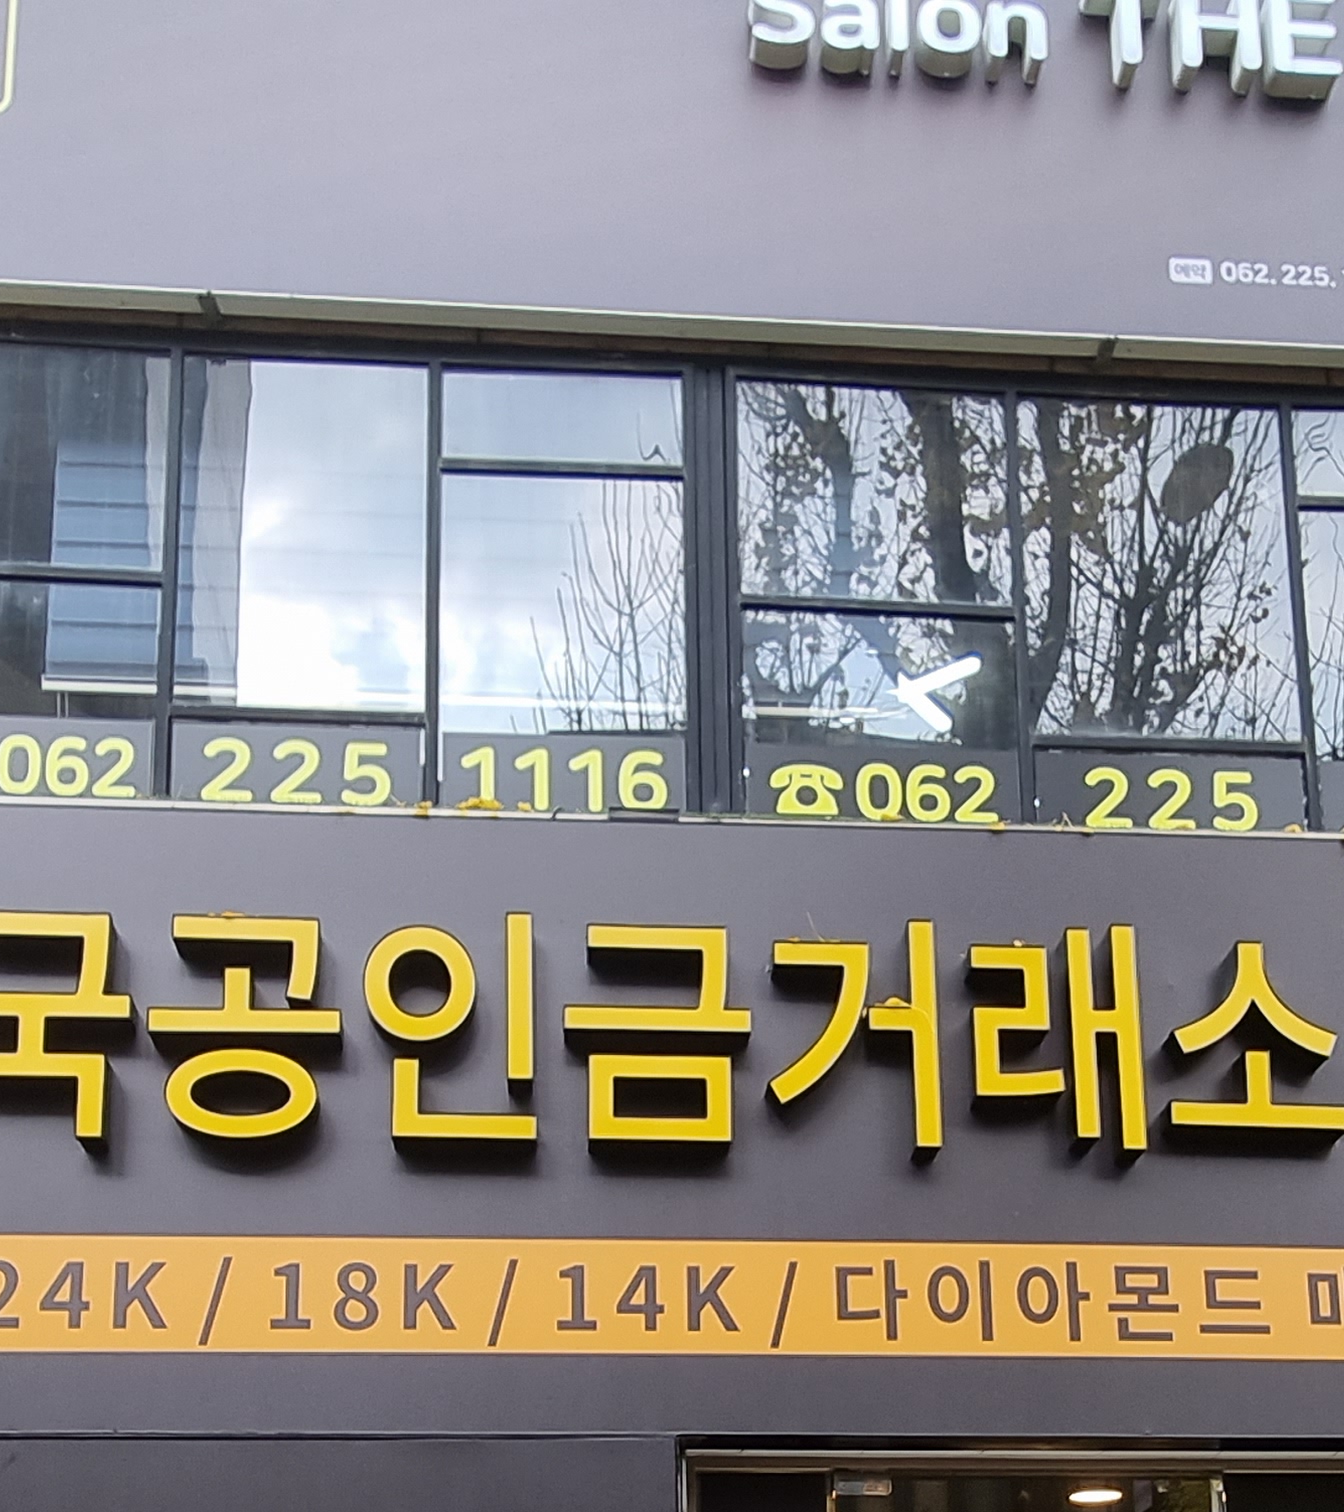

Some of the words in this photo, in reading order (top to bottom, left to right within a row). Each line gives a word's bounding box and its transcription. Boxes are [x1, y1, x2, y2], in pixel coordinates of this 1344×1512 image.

[749, 0, 1048, 78] Salon
[200, 737, 392, 807] 225
[460, 746, 669, 812] 1116
[855, 762, 1000, 824] 062
[1084, 766, 1260, 832] 225
